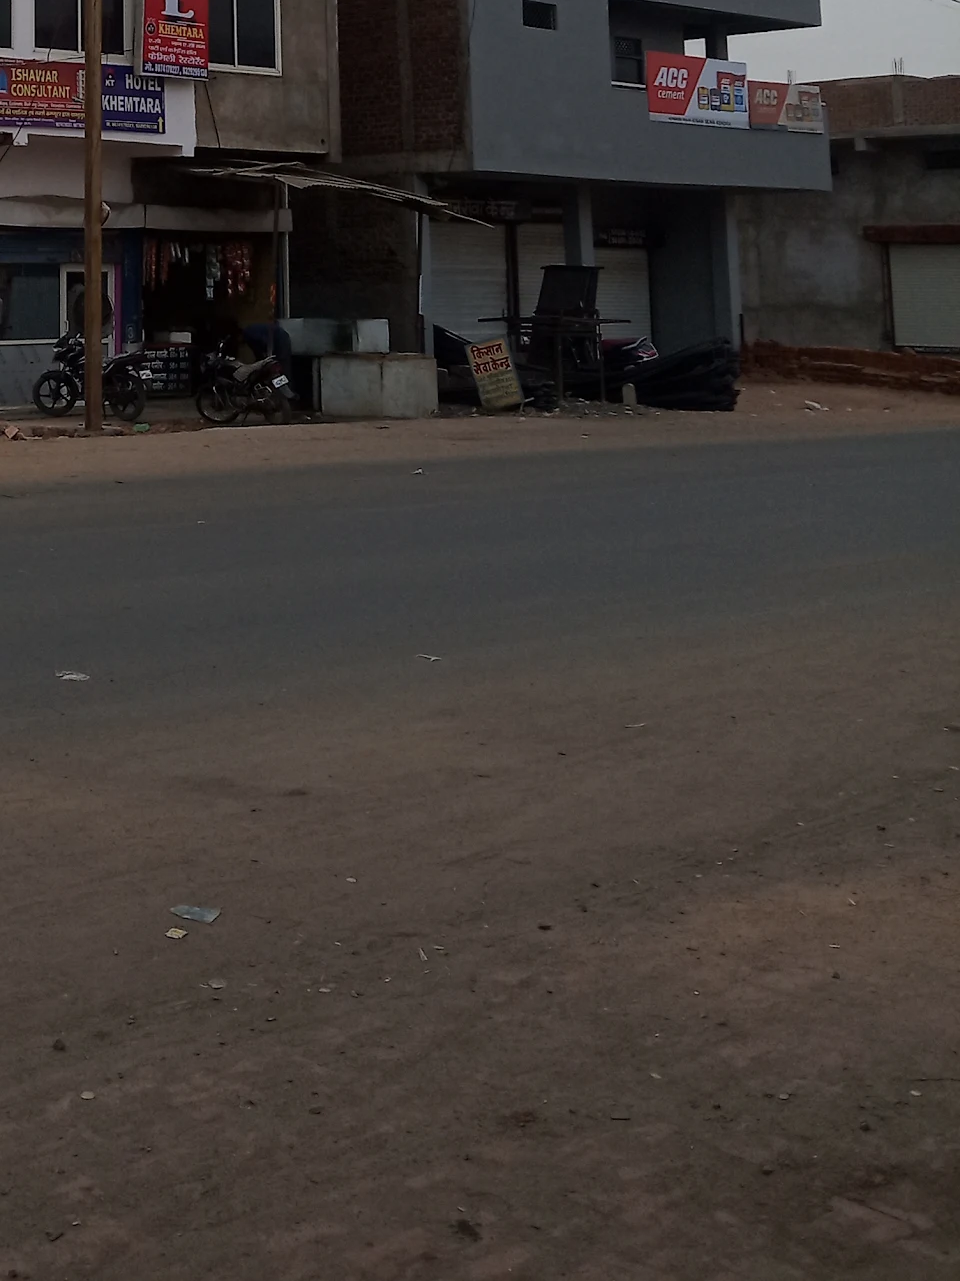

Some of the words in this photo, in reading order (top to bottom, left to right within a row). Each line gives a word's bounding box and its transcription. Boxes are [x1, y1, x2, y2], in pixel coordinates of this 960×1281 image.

[158, 21, 204, 39] KHEMTARA
[11, 68, 58, 83] ISHAWAR
[125, 74, 161, 92] HOTEL
[654, 67, 689, 89] ACC
[11, 84, 71, 99] CONSULTANT
[657, 90, 685, 100] cement
[754, 88, 778, 105] ACC
[102, 95, 162, 114] KHEMTARA
[471, 343, 503, 359] किसान
[474, 360, 492, 375] सेवा
[490, 356, 511, 371] केन्द्र
